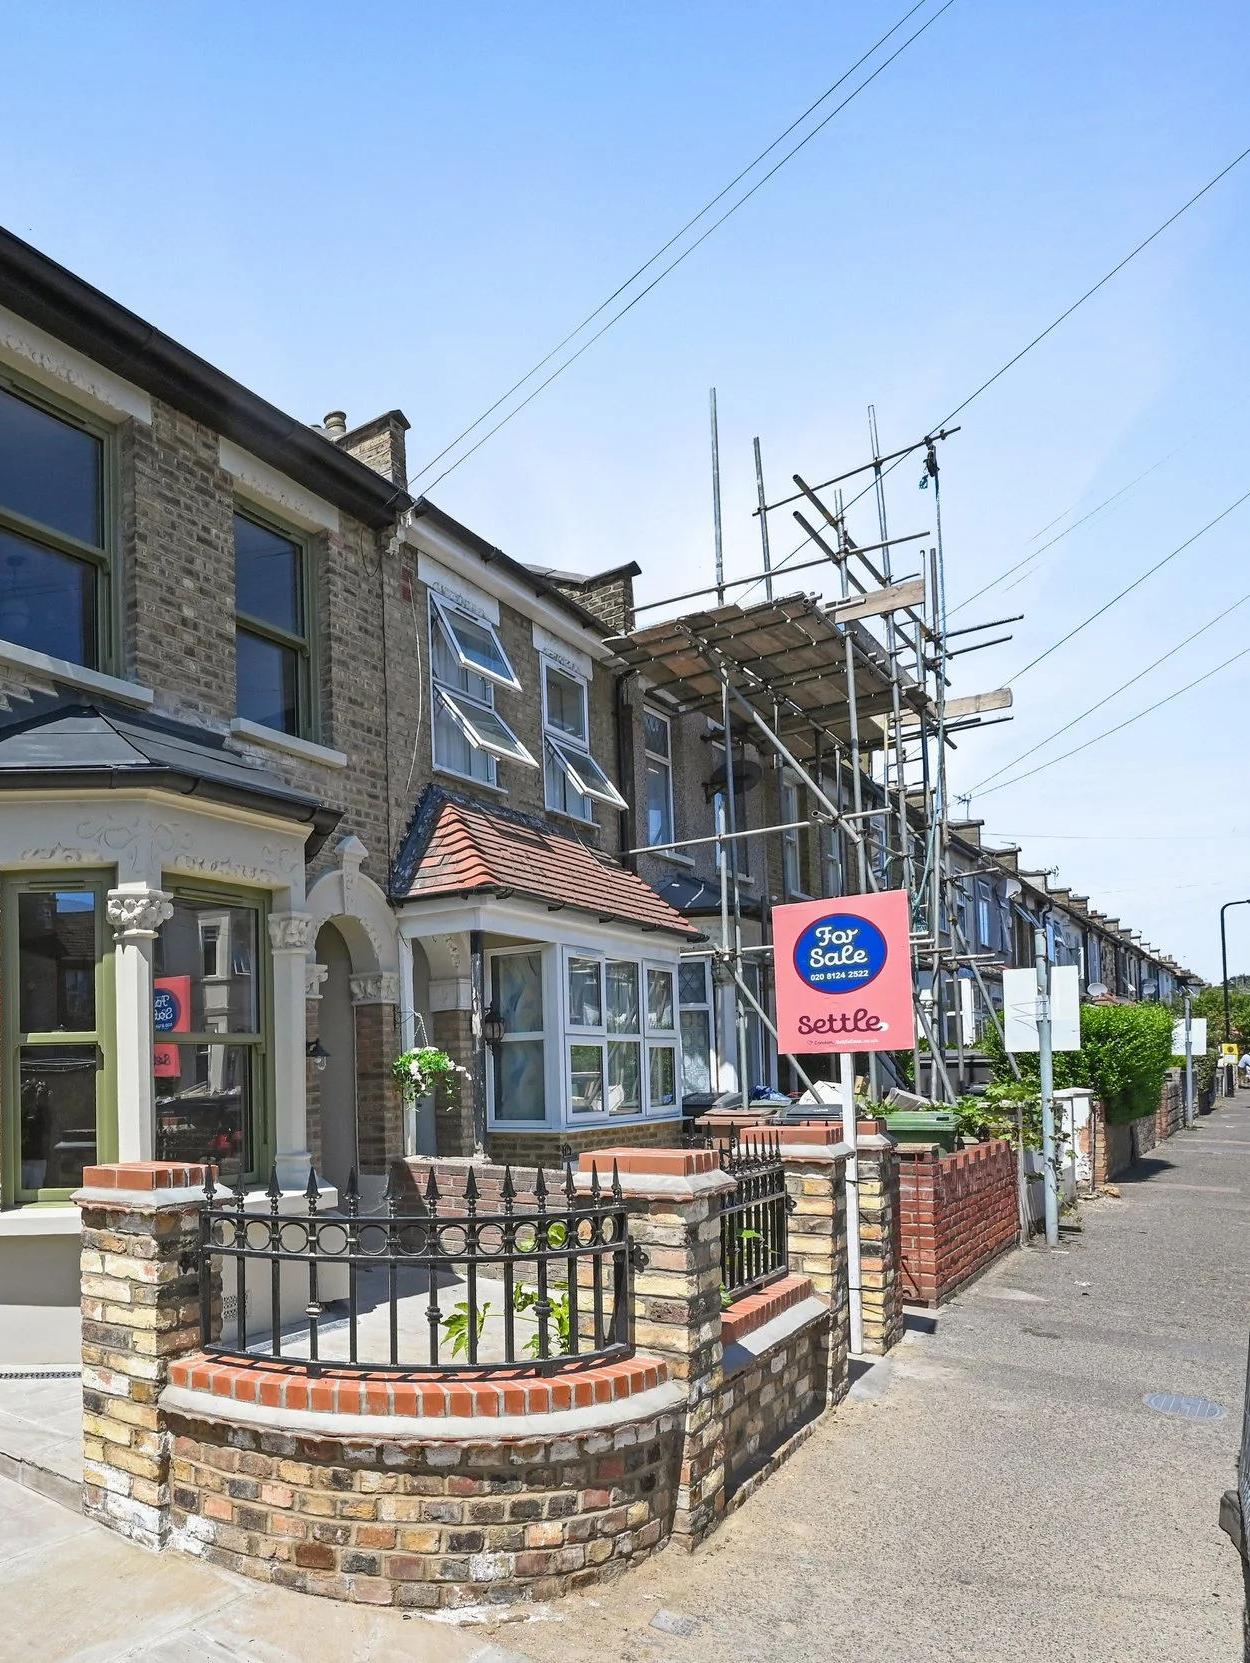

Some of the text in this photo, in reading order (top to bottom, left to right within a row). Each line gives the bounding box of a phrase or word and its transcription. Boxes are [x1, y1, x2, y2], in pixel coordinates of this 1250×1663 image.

[815, 926, 858, 946] For
[810, 945, 868, 968] Sale
[826, 972, 846, 980] 8124
[848, 970, 868, 978] 2522
